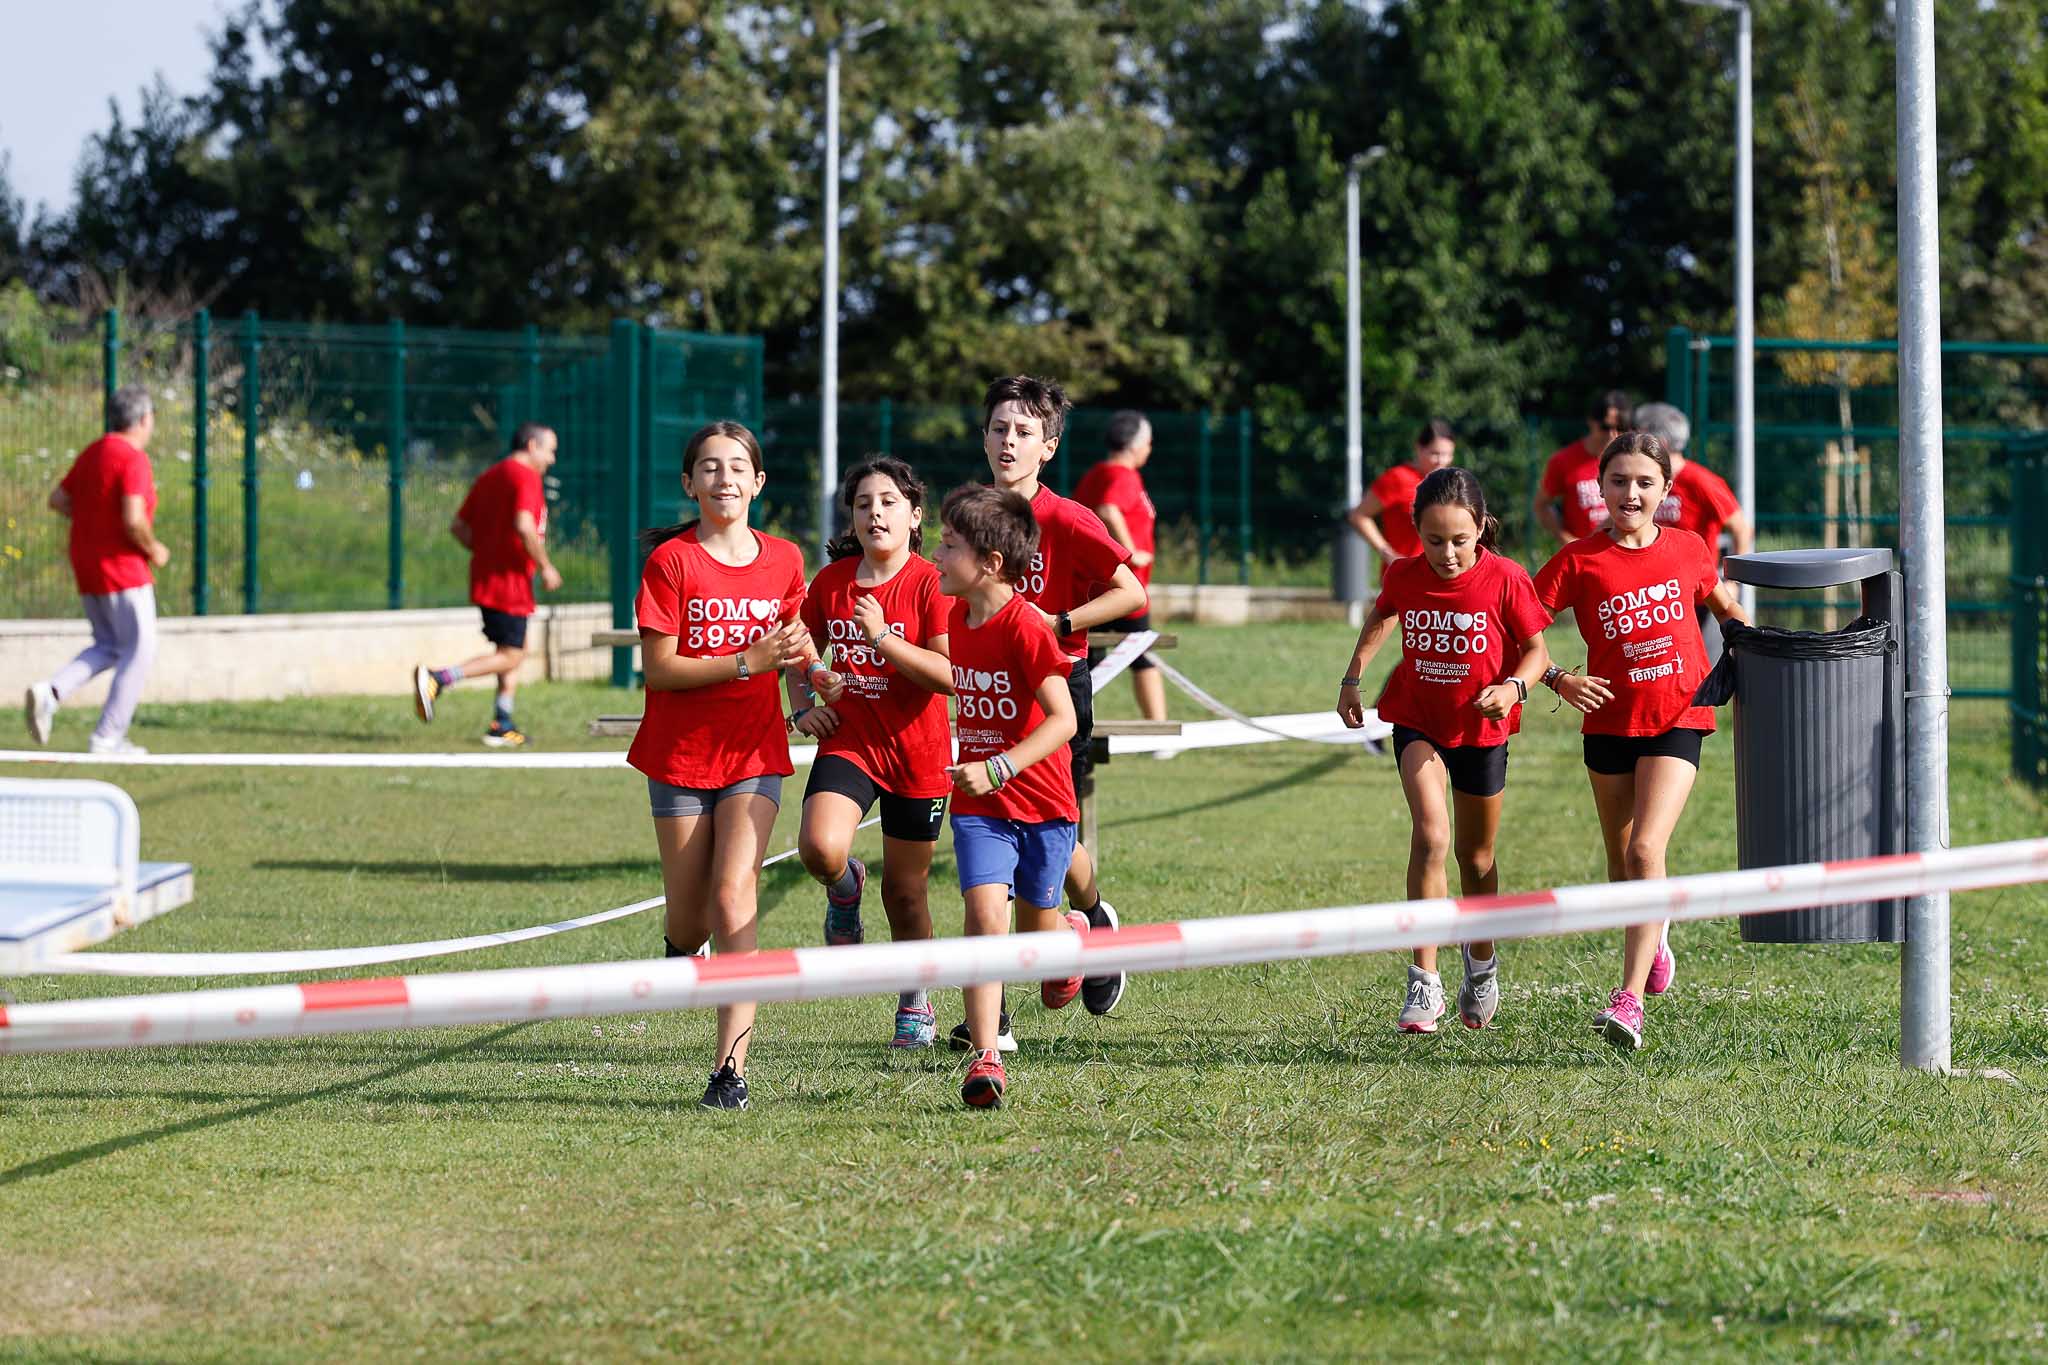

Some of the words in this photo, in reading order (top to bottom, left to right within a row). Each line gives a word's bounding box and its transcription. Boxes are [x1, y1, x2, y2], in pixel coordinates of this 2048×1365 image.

[1603, 600, 1685, 640] 39300
[687, 624, 772, 649] 3930
[1404, 631, 1488, 654] 39300
[1421, 660, 1471, 670] AYUNTAMIENTO
[1421, 666, 1470, 676] TORRELAVEGA
[1628, 662, 1674, 683] Tenysol
